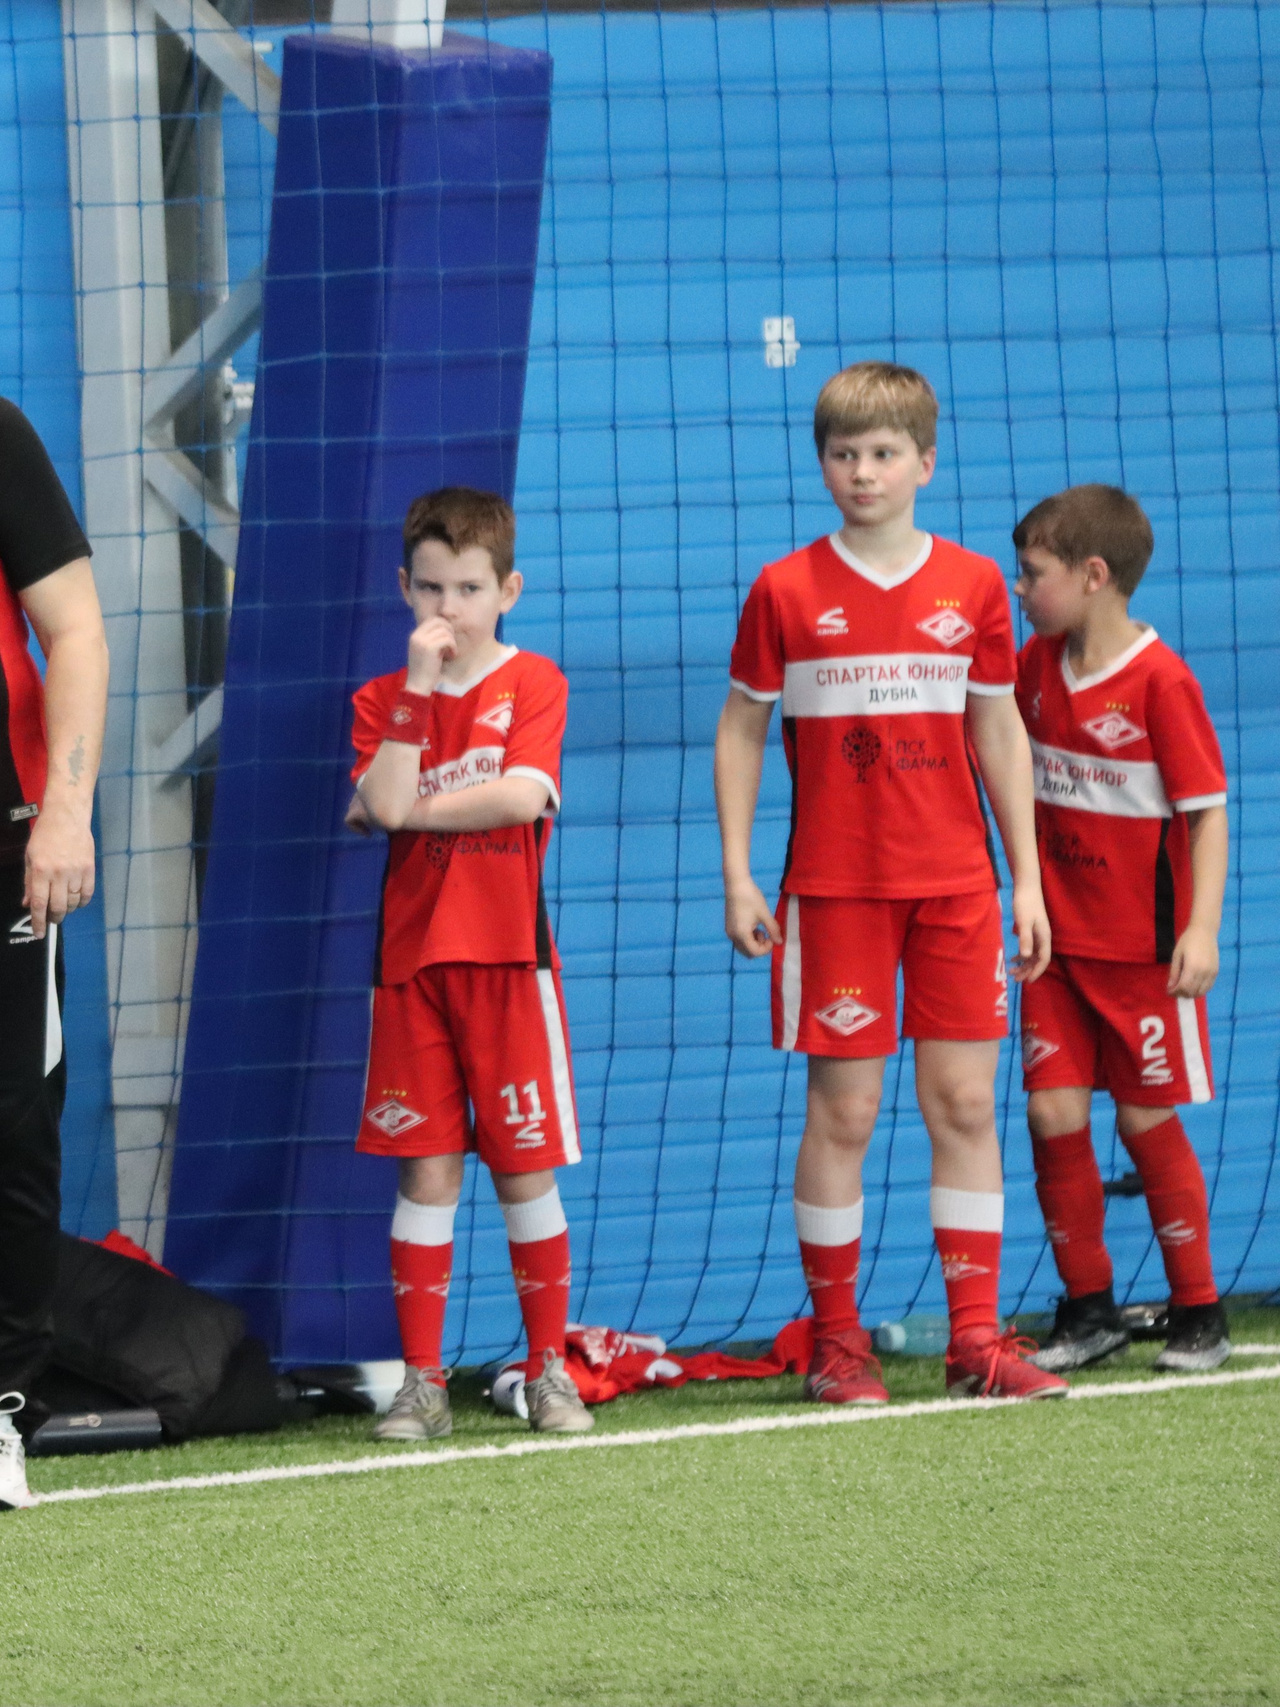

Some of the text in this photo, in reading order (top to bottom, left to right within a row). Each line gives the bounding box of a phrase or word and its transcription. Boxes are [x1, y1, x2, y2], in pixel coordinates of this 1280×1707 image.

[816, 664, 964, 686] СПАРТАК ЮНИОР
[869, 687, 919, 703] ДУБНА
[895, 757, 948, 771] ФАРМА
[1069, 764, 1128, 787] ЮНИОР
[1140, 1015, 1166, 1061] 2
[500, 1080, 547, 1125] 11
